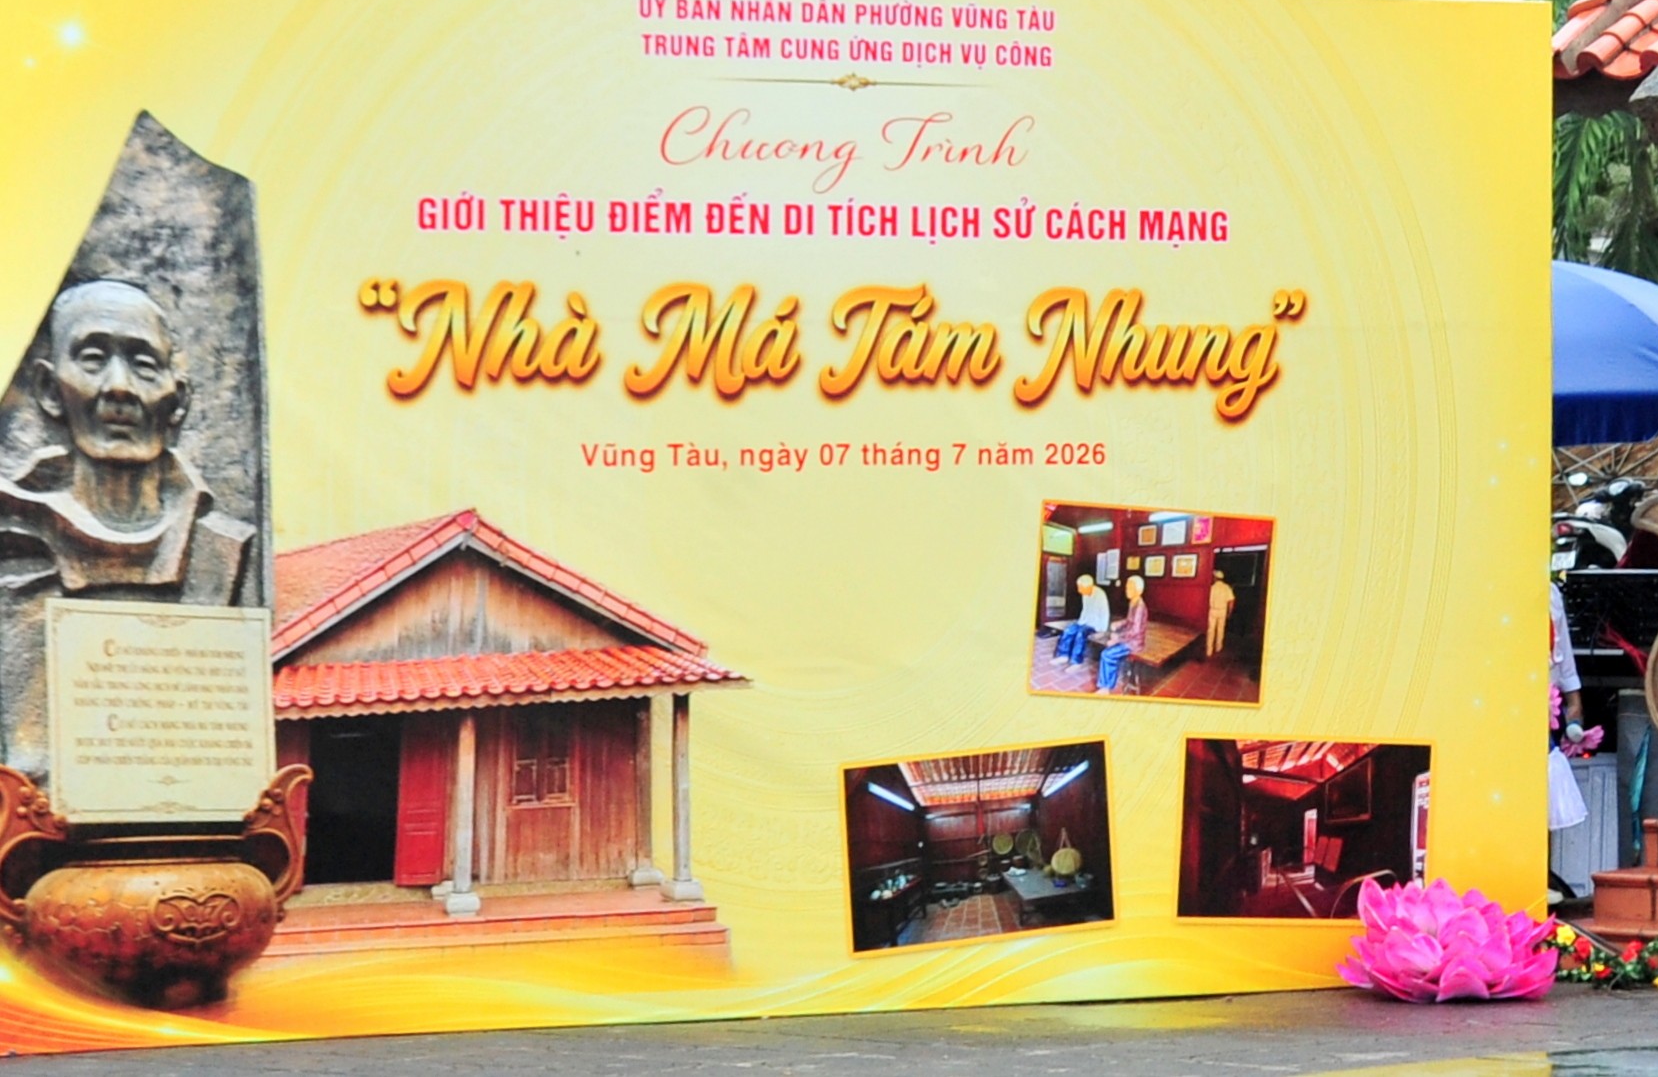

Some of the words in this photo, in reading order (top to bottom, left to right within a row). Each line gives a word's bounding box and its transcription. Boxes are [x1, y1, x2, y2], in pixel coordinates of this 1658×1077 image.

[855, 0, 944, 27] PHƯỜNG
[951, 3, 1008, 30] VŨNG
[1016, 5, 1056, 31] TÀU
[641, 33, 716, 57] TRUNG
[724, 31, 771, 58] TÂM
[780, 38, 840, 61] CUNG
[849, 35, 893, 62] ỨNG
[901, 41, 952, 68] DỊCH
[960, 43, 987, 70] VỤ
[995, 40, 1053, 67] CÔNG
[881, 111, 1036, 172] Trình
[417, 191, 486, 231] GIỚI
[499, 192, 596, 240] THIỆU
[608, 187, 692, 234] ĐIỂM
[705, 192, 771, 235] ĐẾN
[783, 204, 815, 236] DI
[827, 197, 899, 236] TÍCH
[911, 205, 981, 245] LỊCH
[992, 196, 1036, 239] SỬ
[1045, 201, 1127, 241] CÁCH
[1138, 209, 1229, 248] MẠNG
[623, 281, 801, 397] Má
[819, 282, 1004, 400] Tám
[581, 443, 656, 473] Vũng
[667, 442, 728, 470] Tàu,
[740, 441, 809, 472] ngày
[819, 443, 850, 466] 07
[861, 441, 941, 472] tháng
[952, 443, 967, 465] 7
[978, 442, 1034, 465] năm
[1044, 443, 1106, 465] 2026
